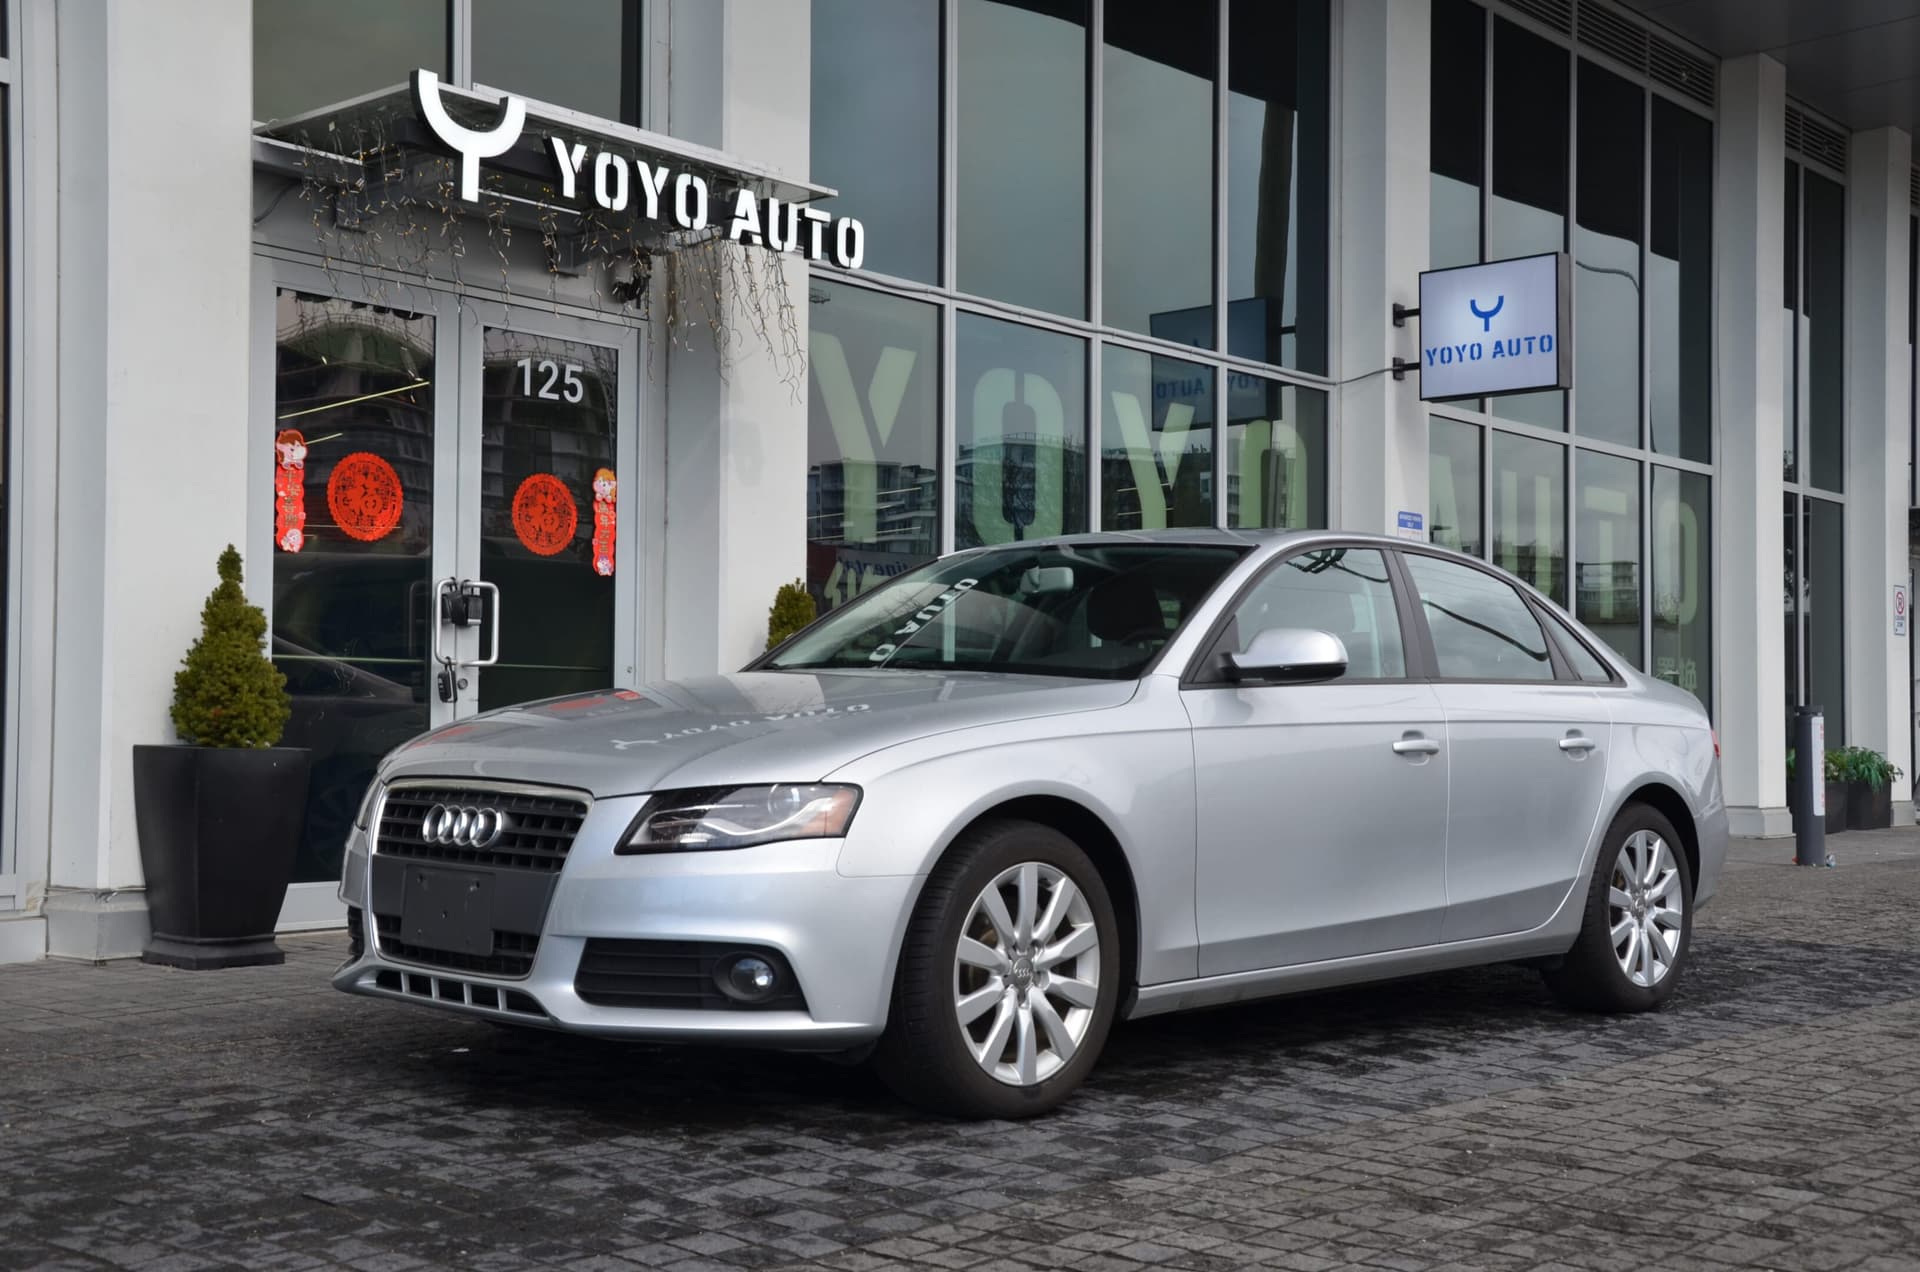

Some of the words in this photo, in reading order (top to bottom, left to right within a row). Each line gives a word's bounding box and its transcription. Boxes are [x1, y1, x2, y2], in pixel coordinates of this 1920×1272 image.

[551, 136, 708, 231] YOYO
[730, 188, 865, 269] AUTO
[517, 358, 584, 403] 125
[1425, 343, 1483, 367] YOYO
[1492, 334, 1553, 359] AUTO
[809, 330, 1308, 547] YOYO
